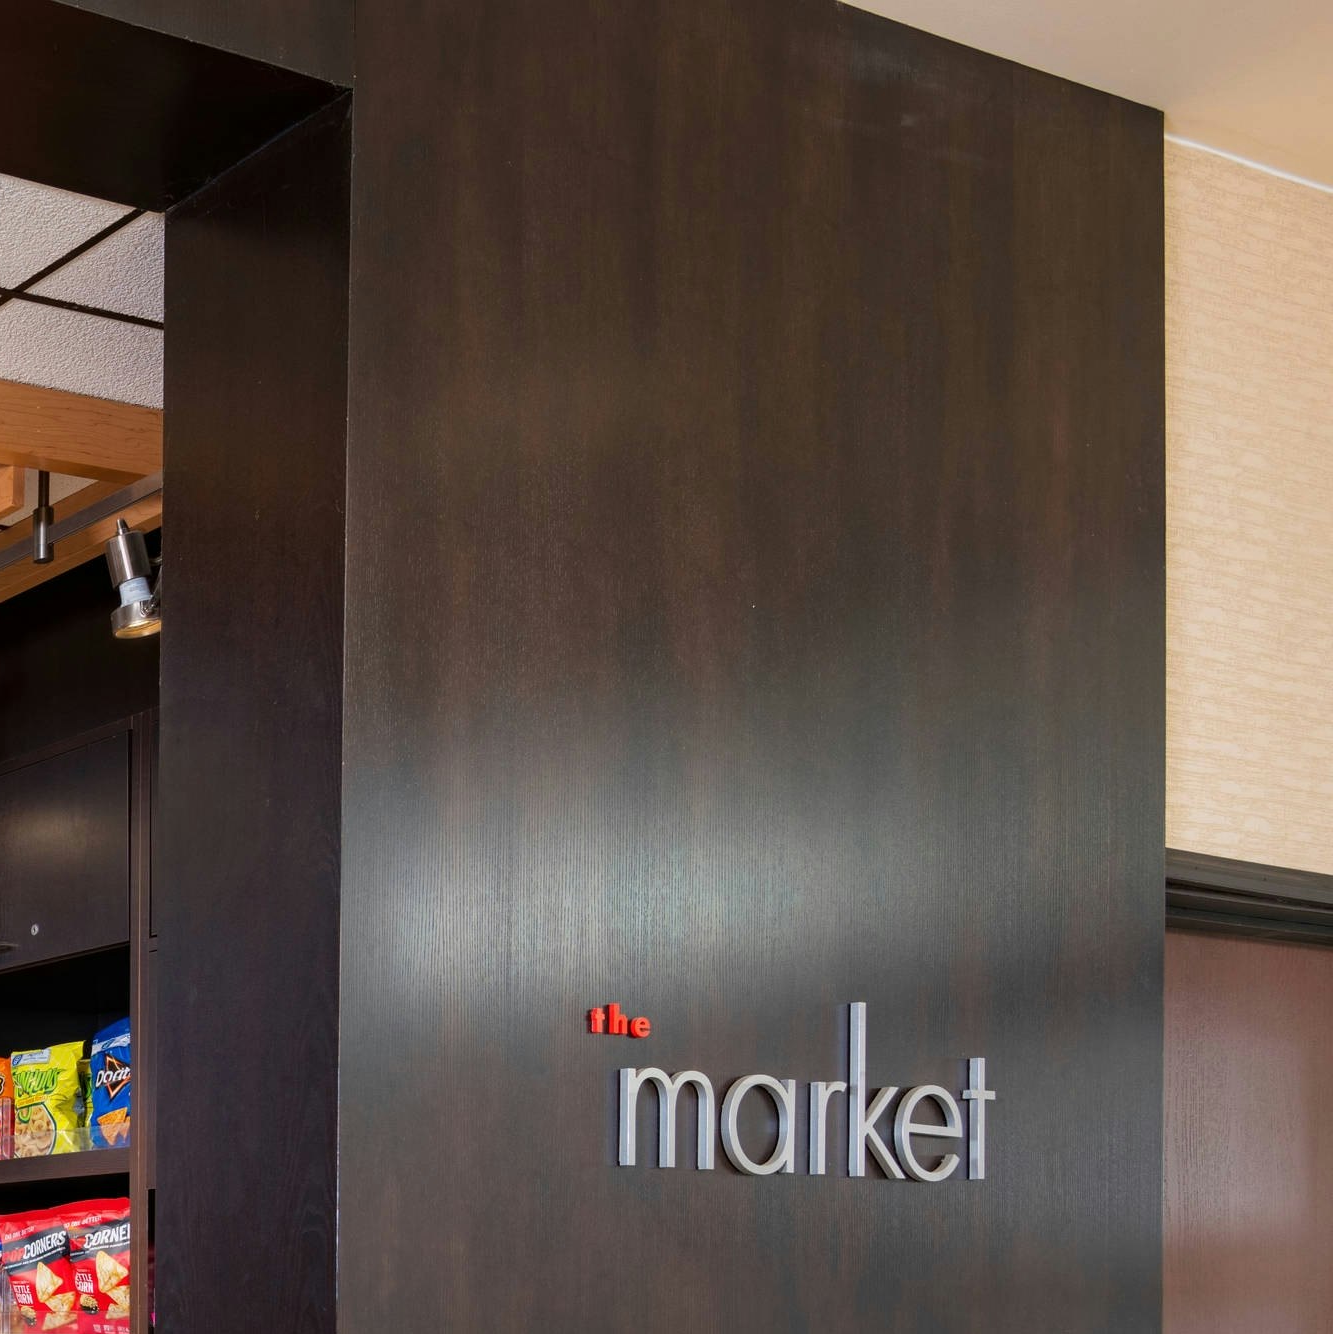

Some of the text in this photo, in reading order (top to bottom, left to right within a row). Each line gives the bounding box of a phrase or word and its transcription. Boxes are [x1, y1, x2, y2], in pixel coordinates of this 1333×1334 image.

[588, 1003, 651, 1038] the
[96, 1066, 130, 1088] Dorit
[619, 1002, 996, 1182] market
